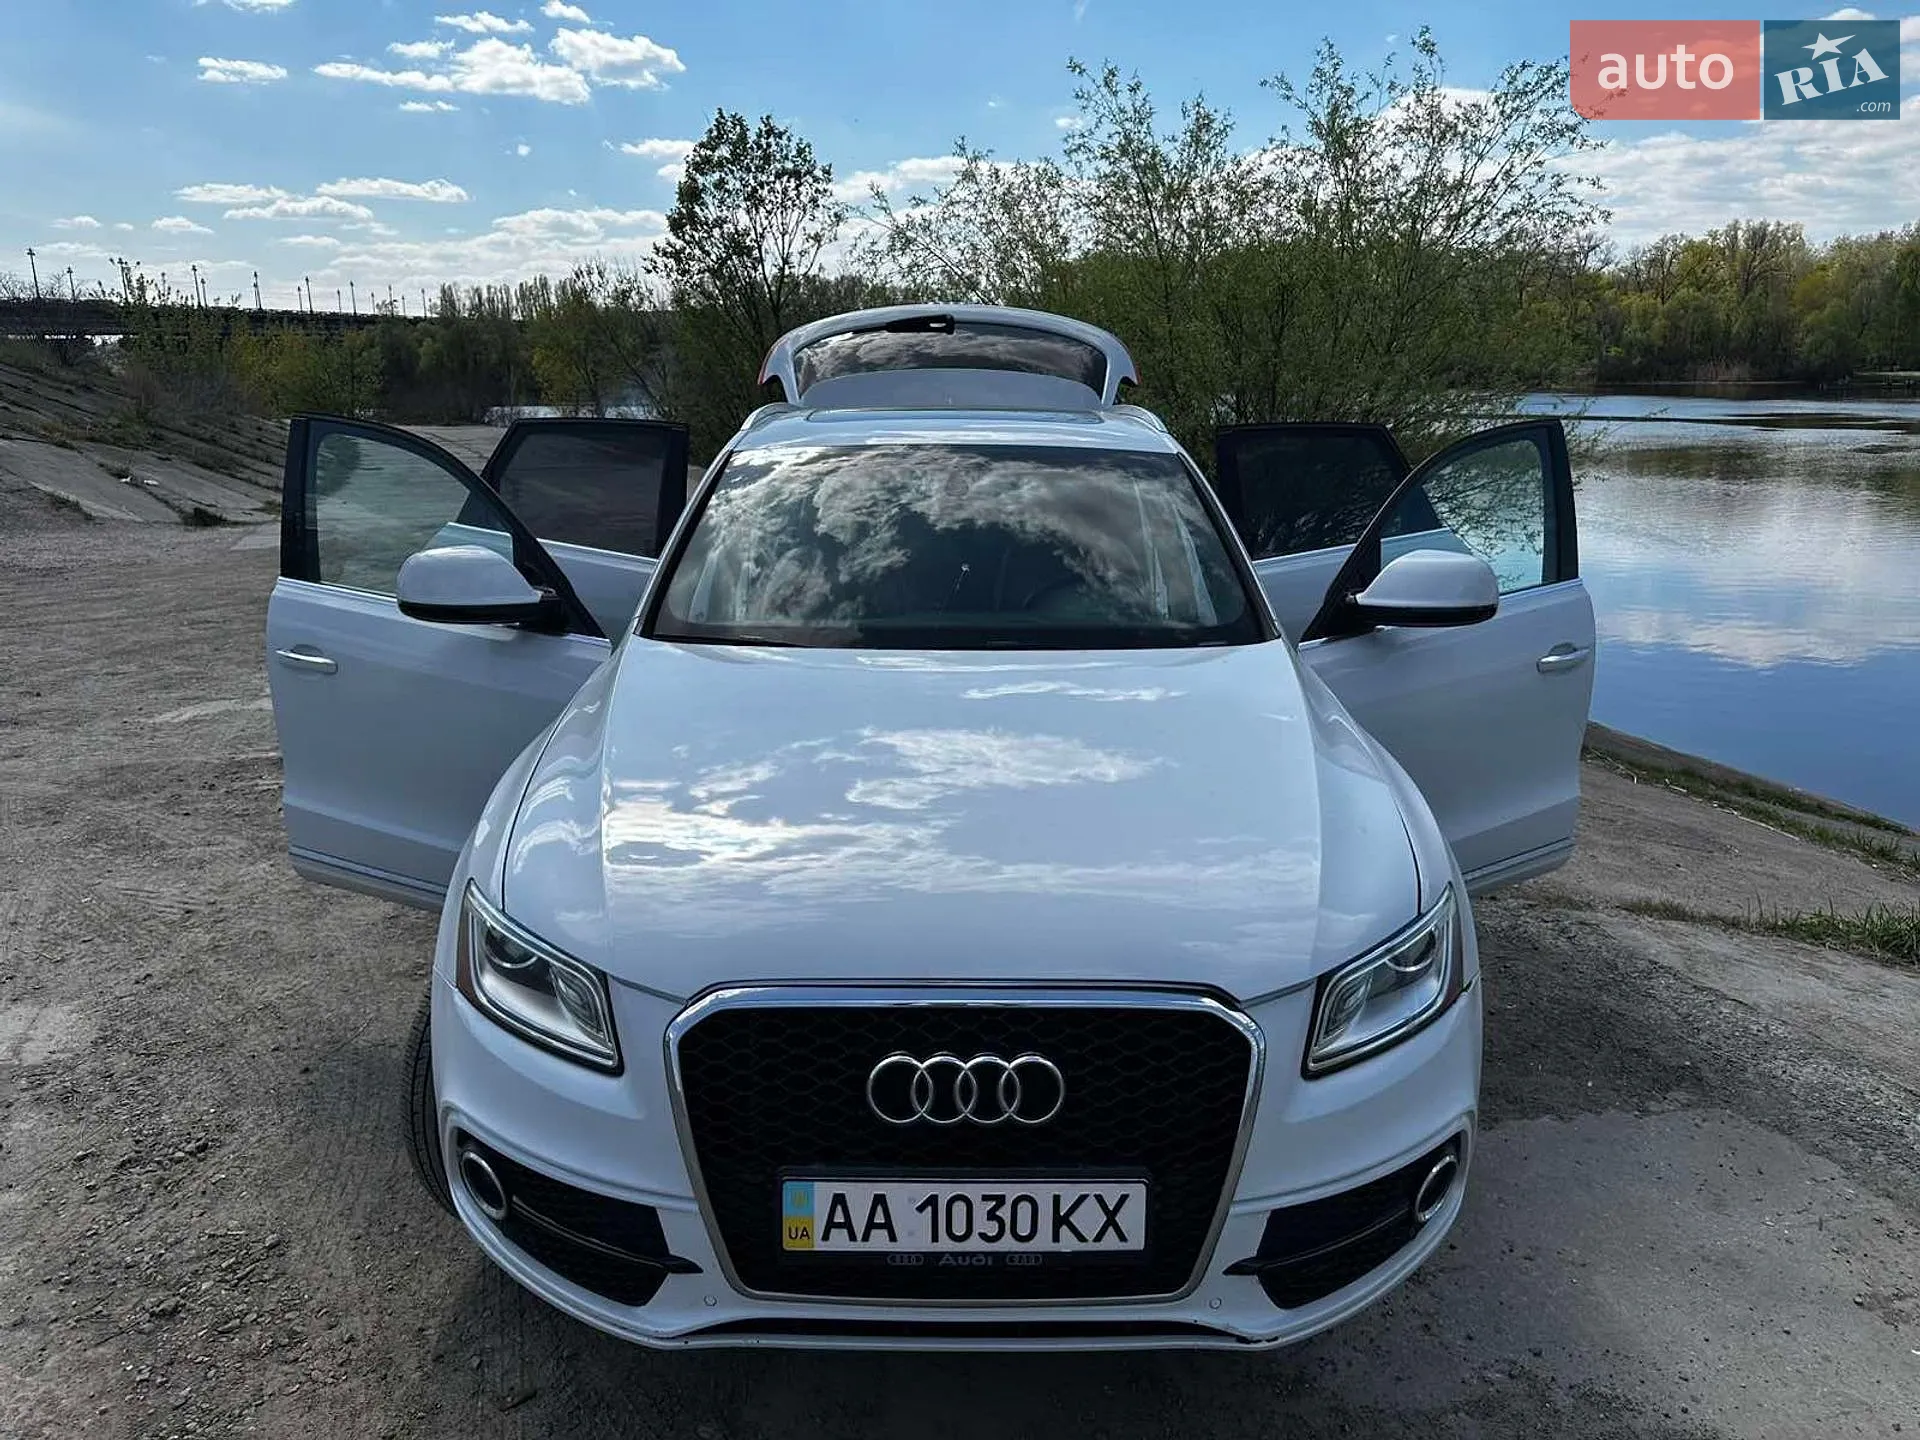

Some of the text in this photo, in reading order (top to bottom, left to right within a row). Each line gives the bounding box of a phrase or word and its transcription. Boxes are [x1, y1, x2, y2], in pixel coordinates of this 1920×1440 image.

[788, 1226, 810, 1241] UA
[821, 1192, 1130, 1243] AA 1030 KX
